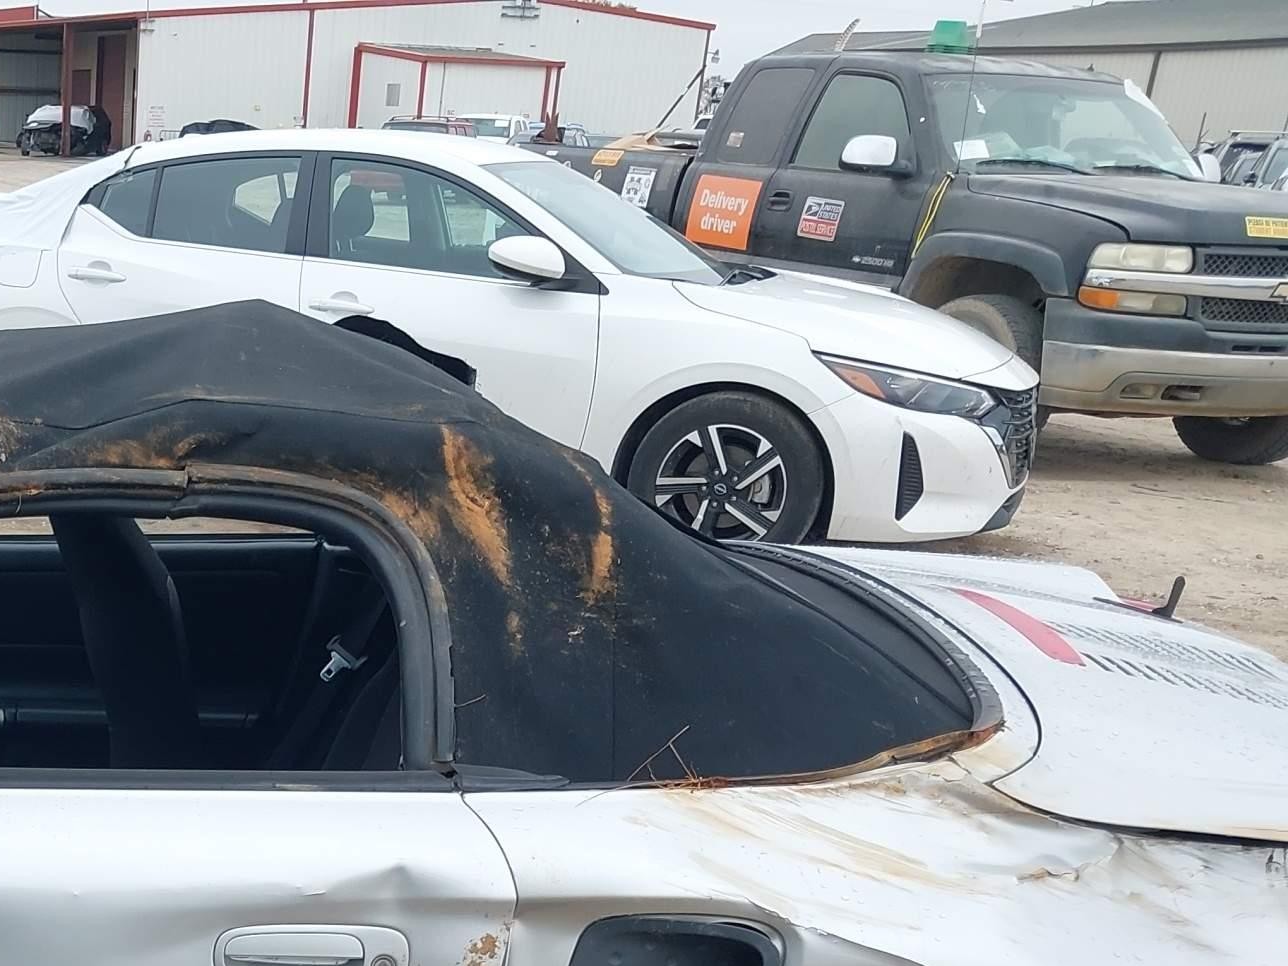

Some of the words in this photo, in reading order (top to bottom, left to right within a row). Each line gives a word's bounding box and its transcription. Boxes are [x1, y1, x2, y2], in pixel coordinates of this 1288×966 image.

[700, 189, 748, 216] Delivery
[700, 212, 736, 234] driver
[818, 211, 838, 220] STATES
